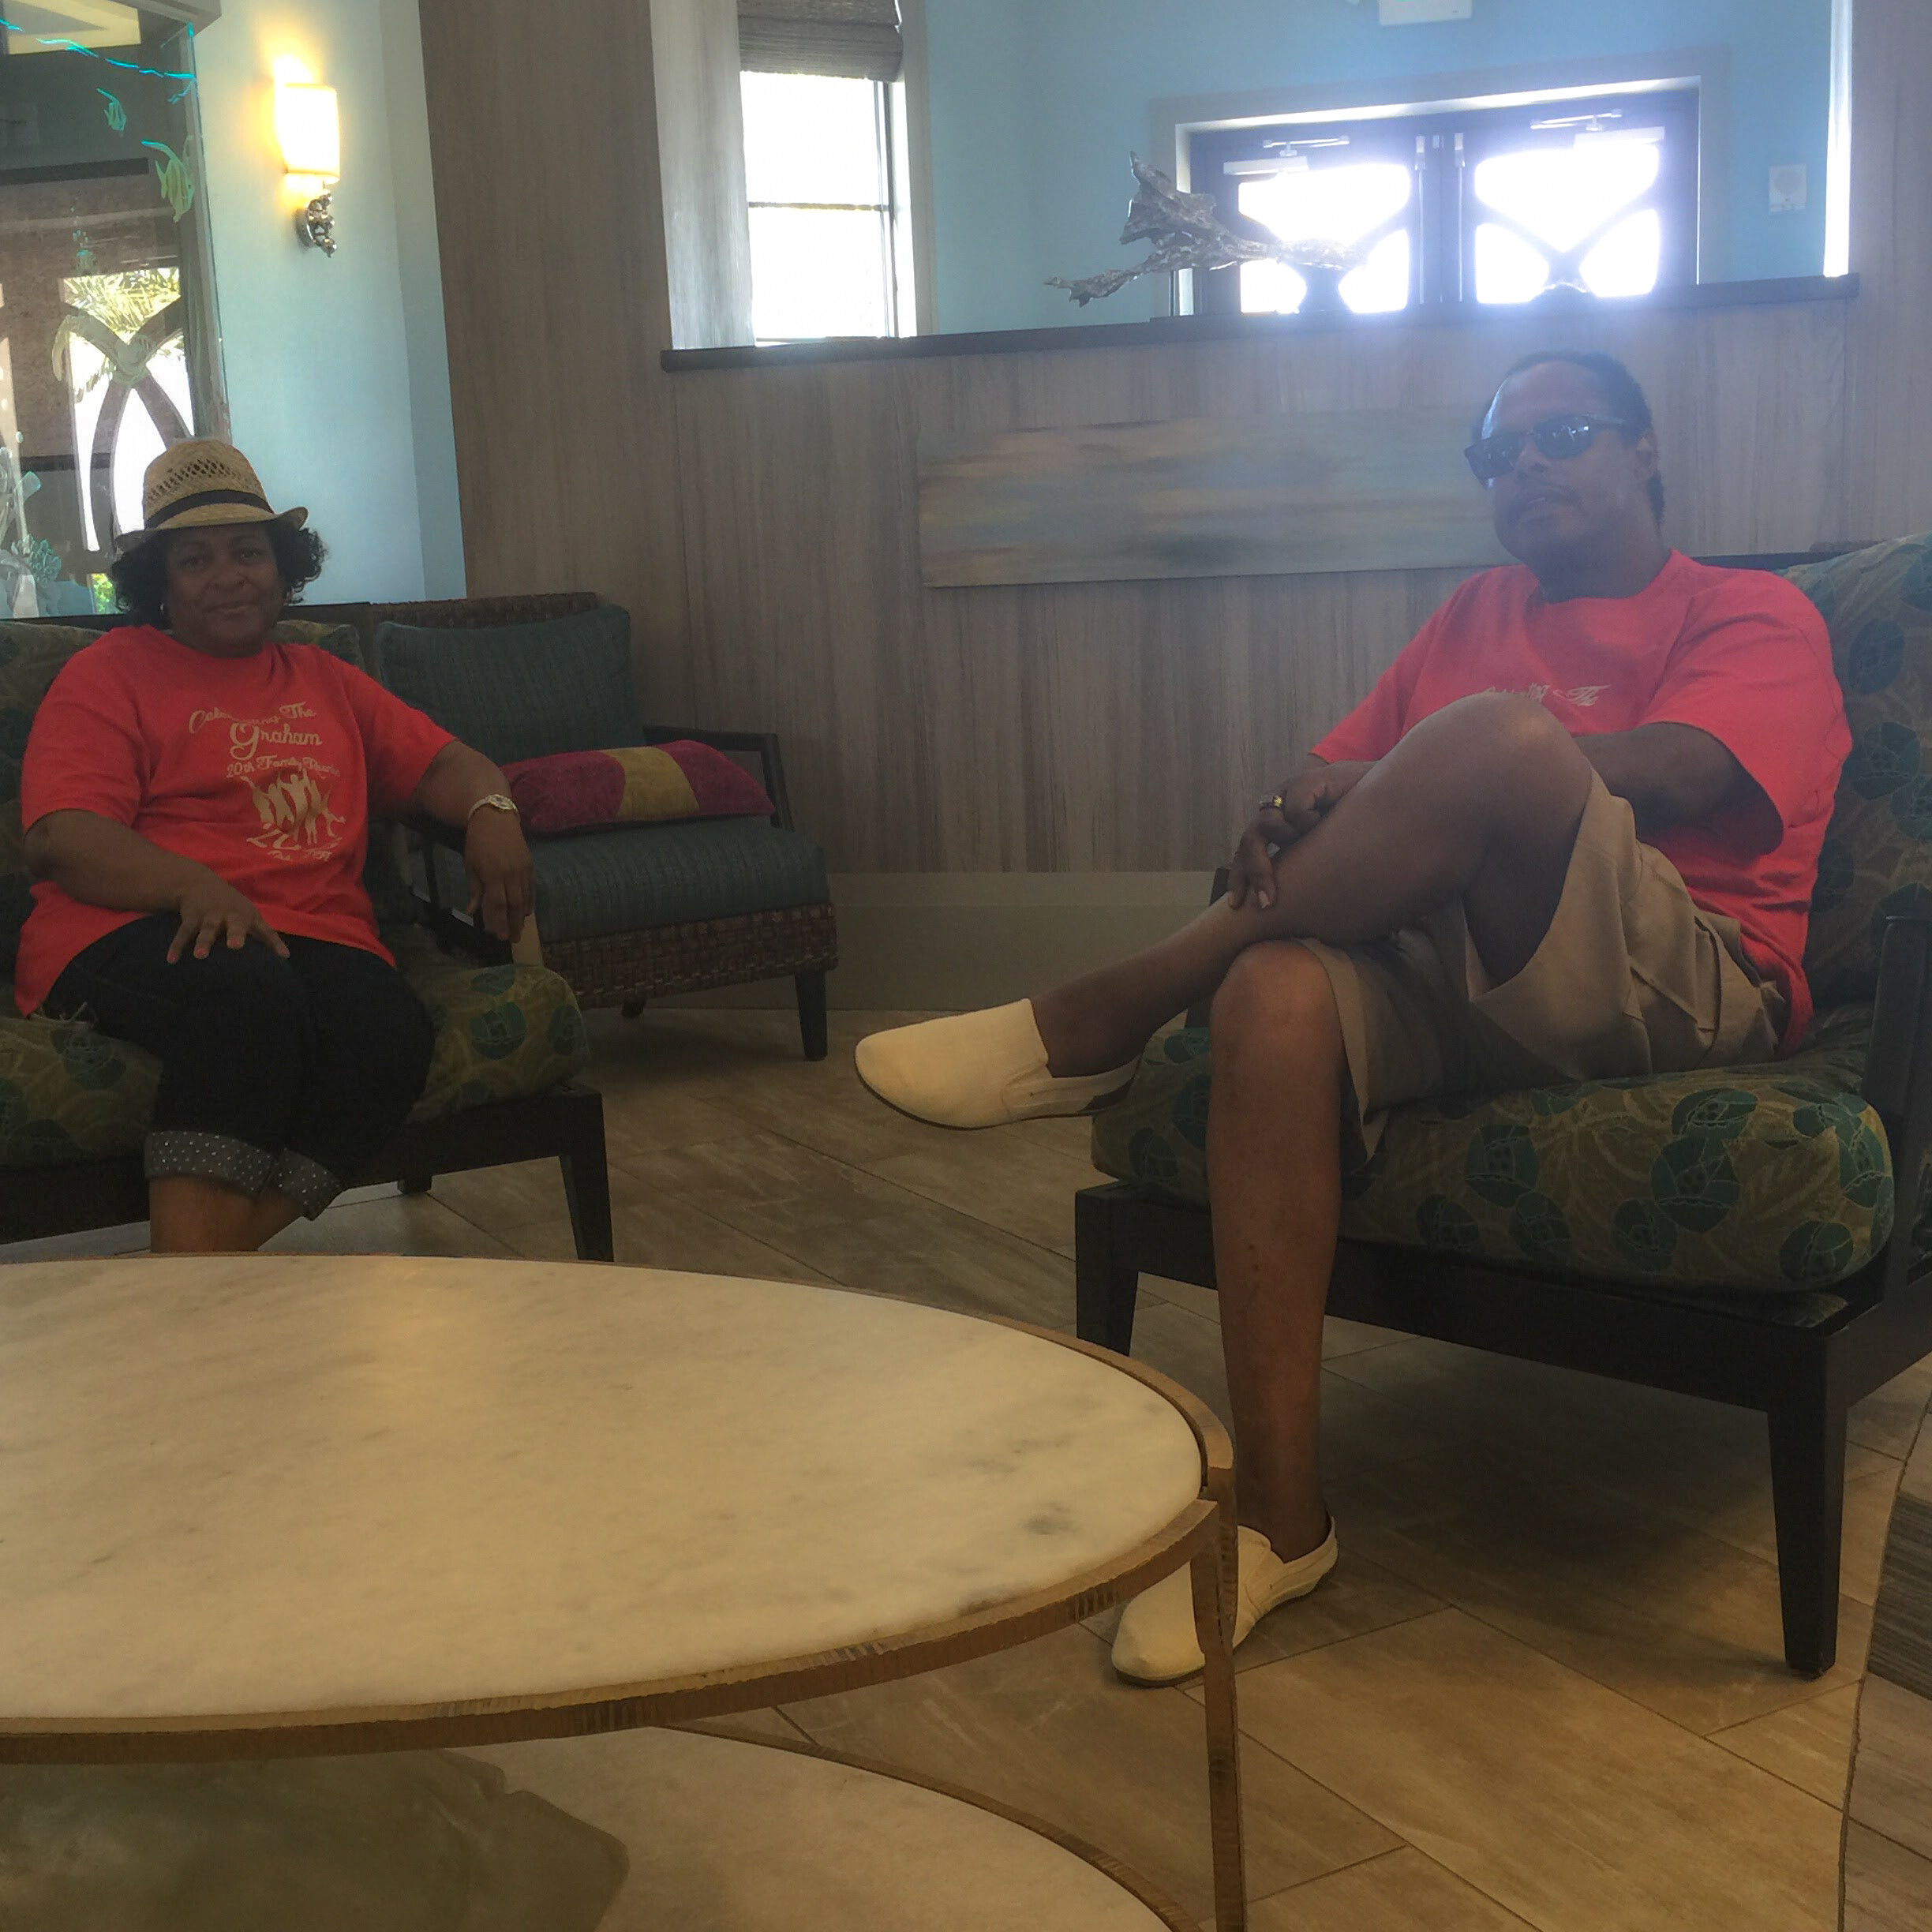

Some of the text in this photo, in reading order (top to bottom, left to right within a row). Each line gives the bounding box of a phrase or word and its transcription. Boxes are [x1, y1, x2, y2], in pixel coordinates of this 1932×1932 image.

[279, 701, 317, 719] The
[229, 722, 323, 761] Graham
[226, 761, 255, 778] 20th
